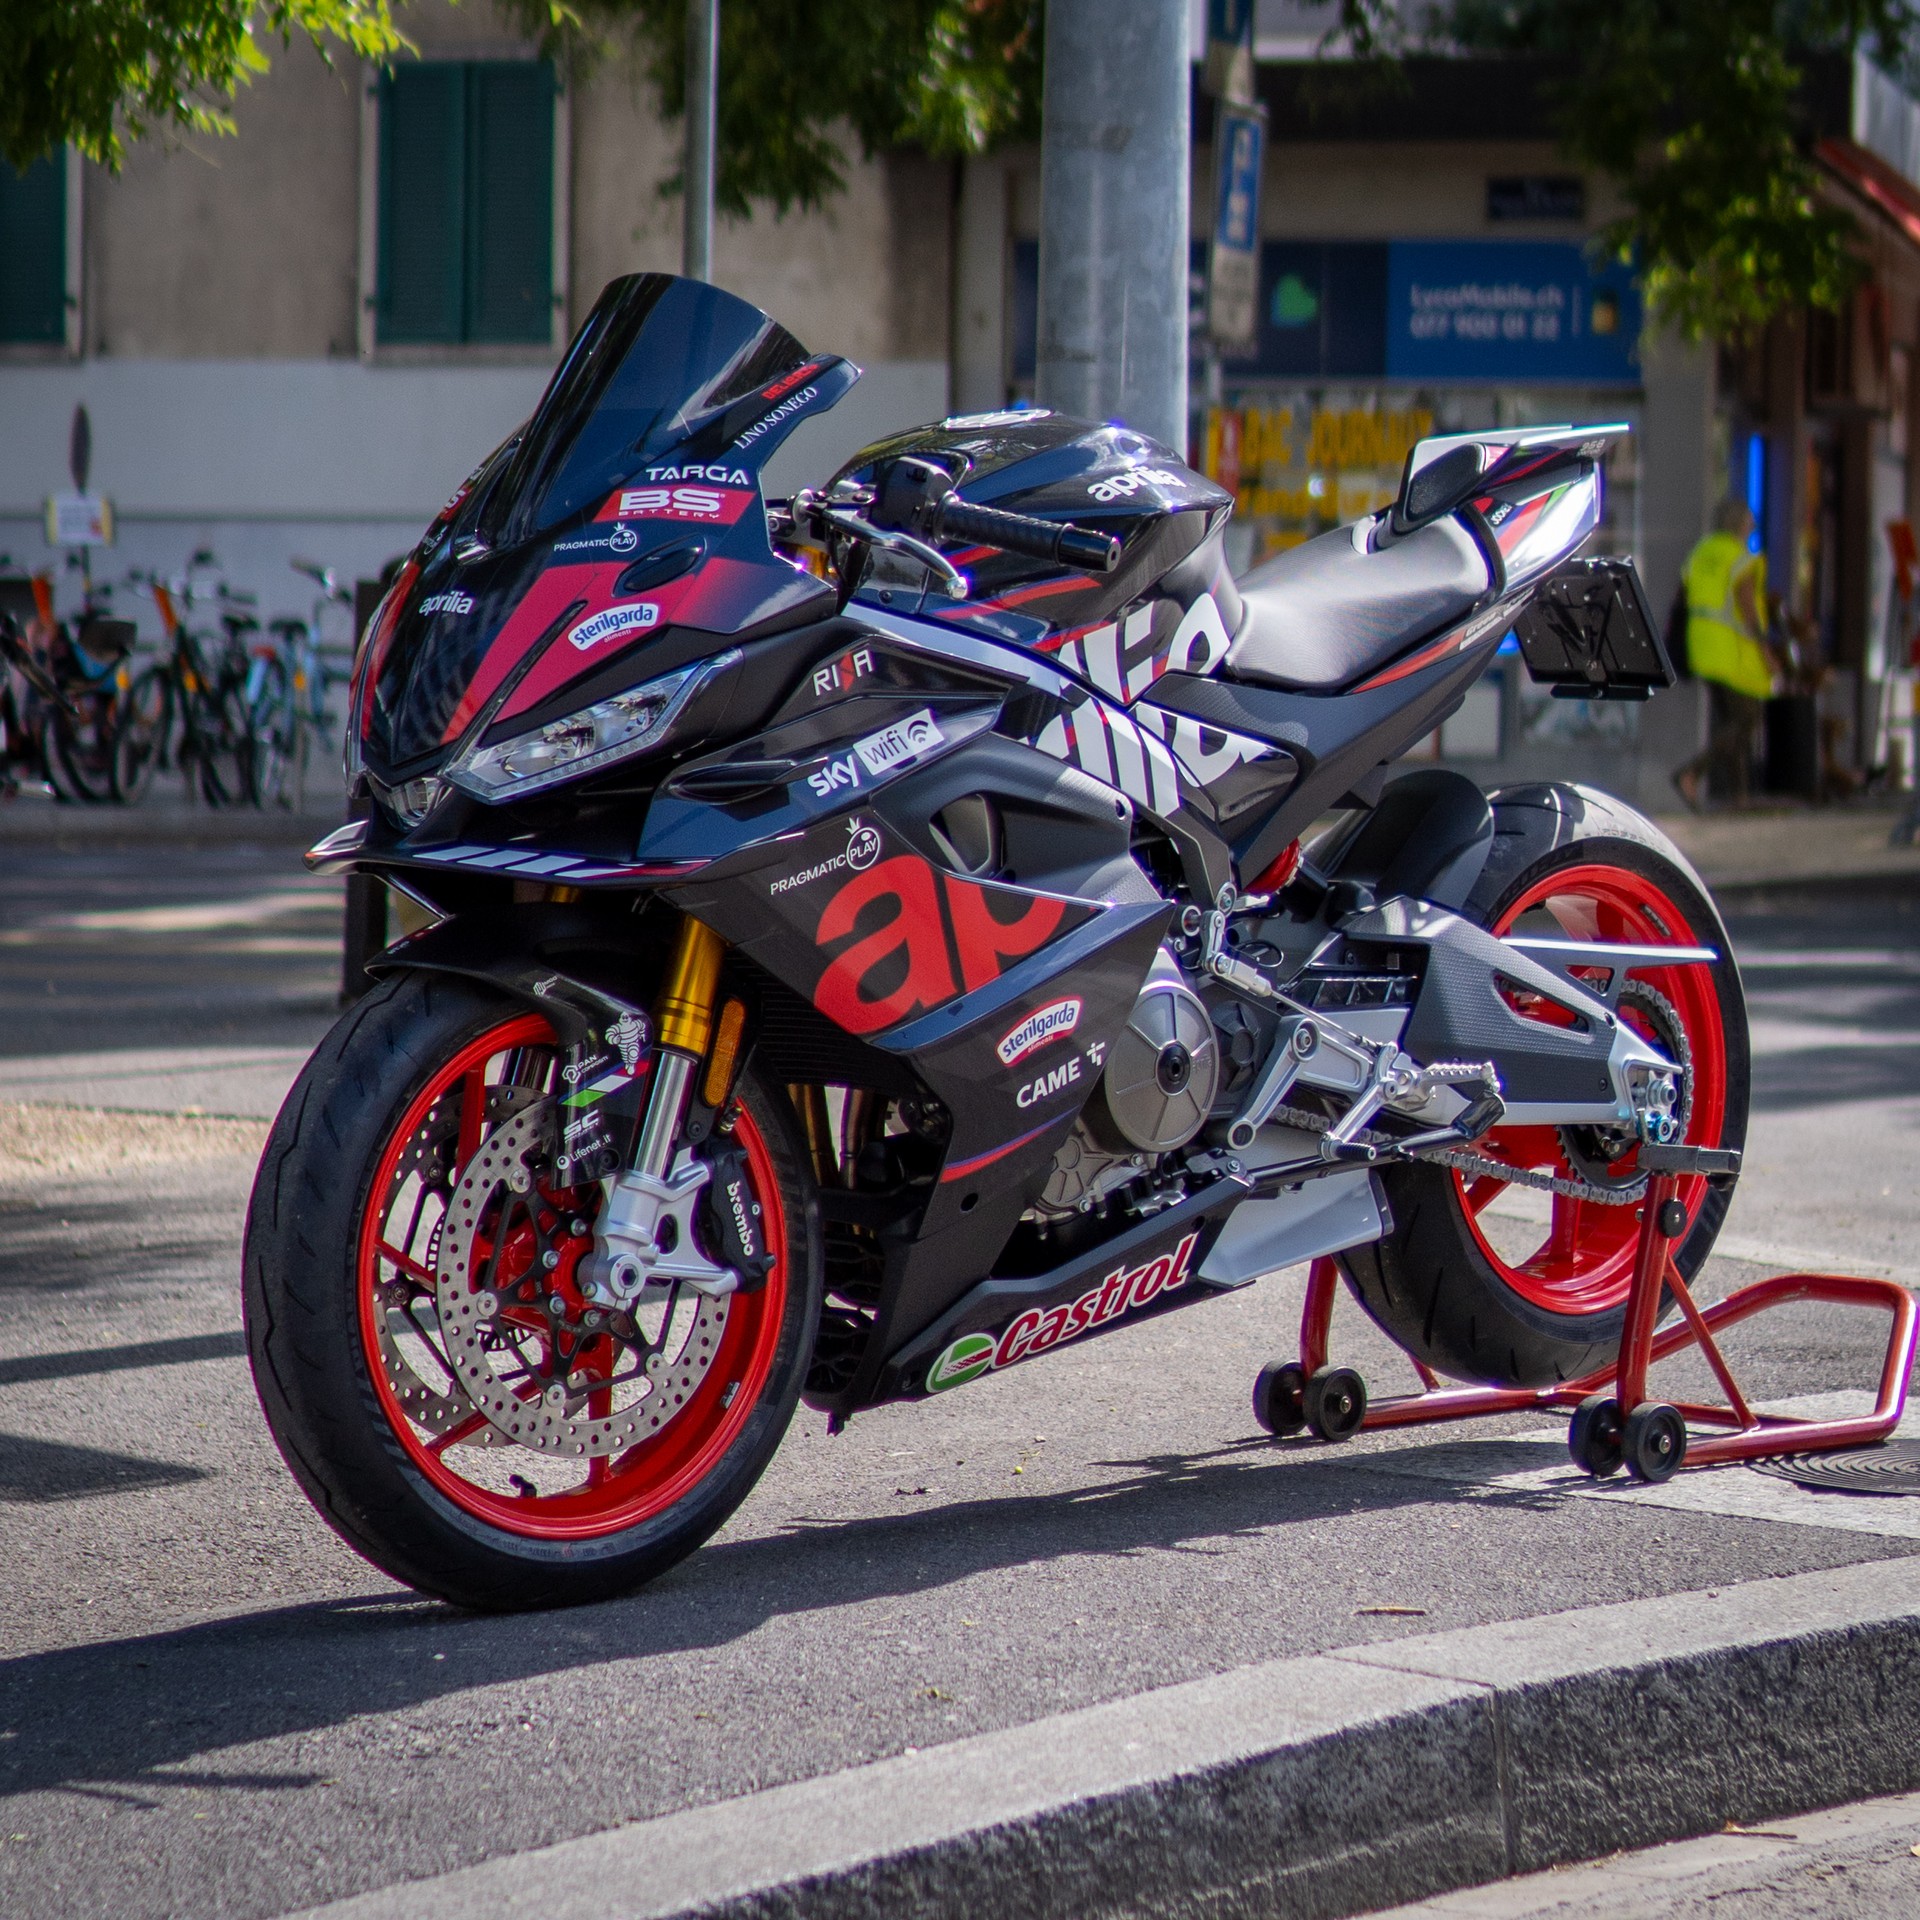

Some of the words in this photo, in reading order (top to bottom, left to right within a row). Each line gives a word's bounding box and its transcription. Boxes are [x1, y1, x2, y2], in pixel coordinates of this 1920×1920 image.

[734, 422, 768, 449] LINO
[764, 387, 818, 426] SONEGO
[646, 465, 749, 485] TARGA
[1087, 466, 1187, 502] aprilia
[619, 509, 720, 519] BATTERY
[620, 489, 720, 512] BS
[554, 538, 610, 551] PRAGMATIC
[612, 536, 635, 546] PLAY
[419, 591, 474, 617] aprilia
[574, 606, 653, 645] sterilgarda
[864, 730, 909, 765] wifi
[770, 855, 847, 895] PRAGMATIC
[849, 837, 878, 861] PLAY
[1002, 1002, 1076, 1058] sterilgarda
[577, 1055, 598, 1069] PAN
[1016, 1057, 1081, 1108] CAME
[563, 1109, 599, 1141] SC
[726, 1180, 754, 1257] brembo
[991, 1232, 1199, 1370] Castrol
